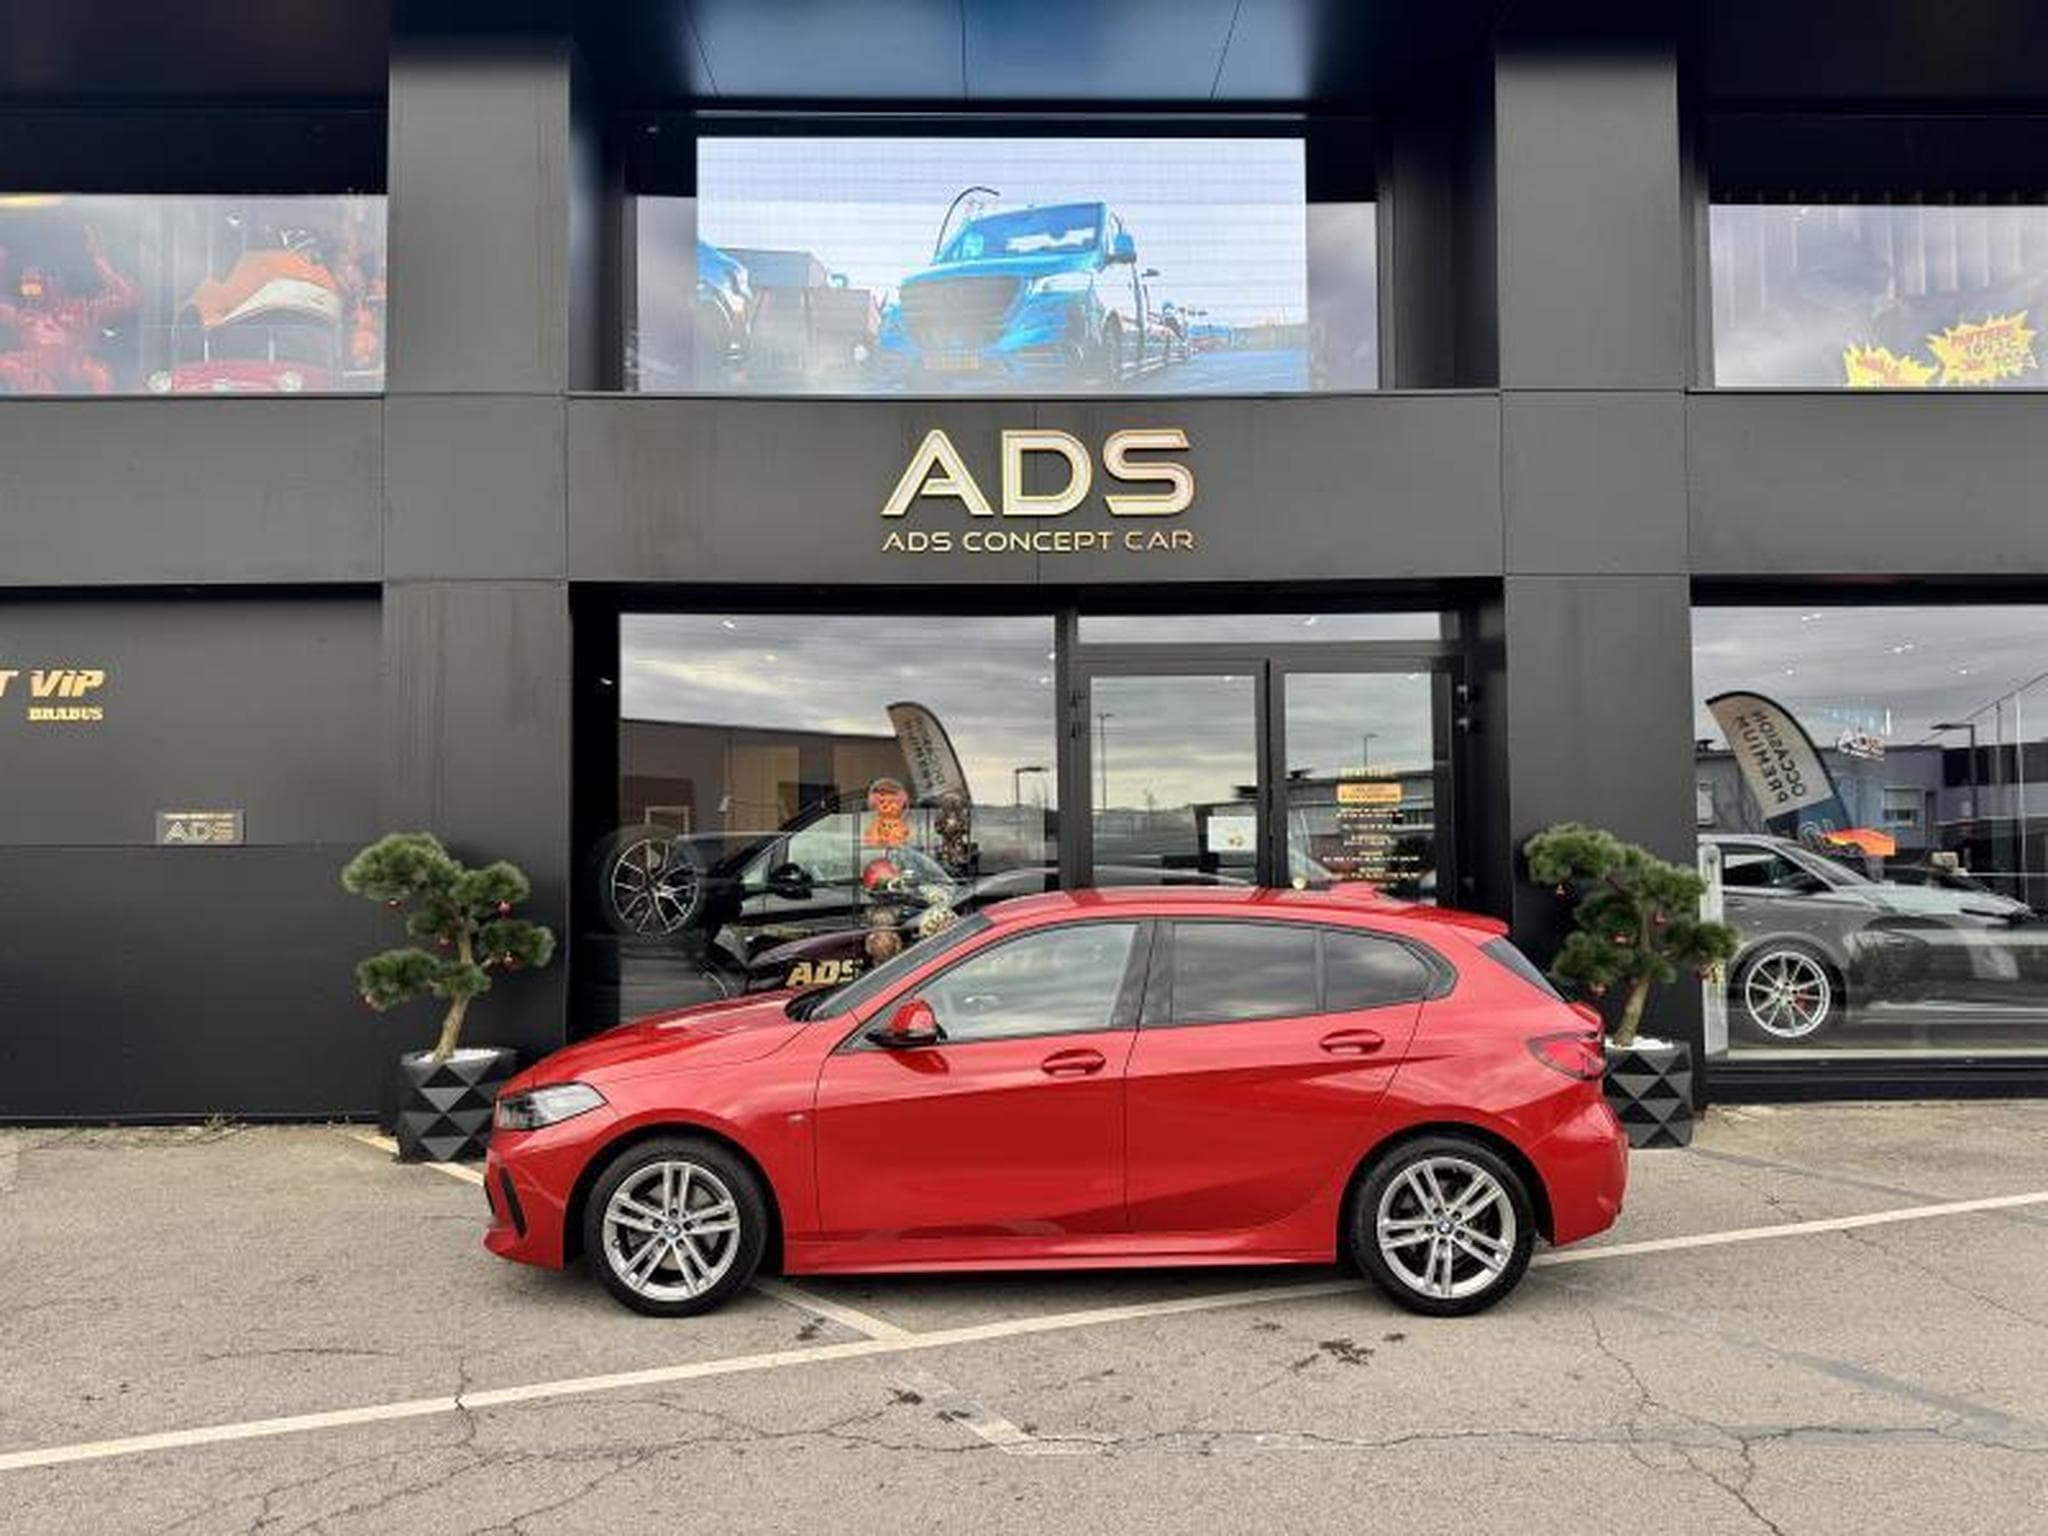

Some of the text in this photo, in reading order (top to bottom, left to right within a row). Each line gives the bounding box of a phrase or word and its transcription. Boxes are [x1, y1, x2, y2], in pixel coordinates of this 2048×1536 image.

[881, 429, 1195, 516] ADS
[882, 531, 1195, 551] ADS CONCEPT CAR
[28, 706, 103, 721] BRABUS
